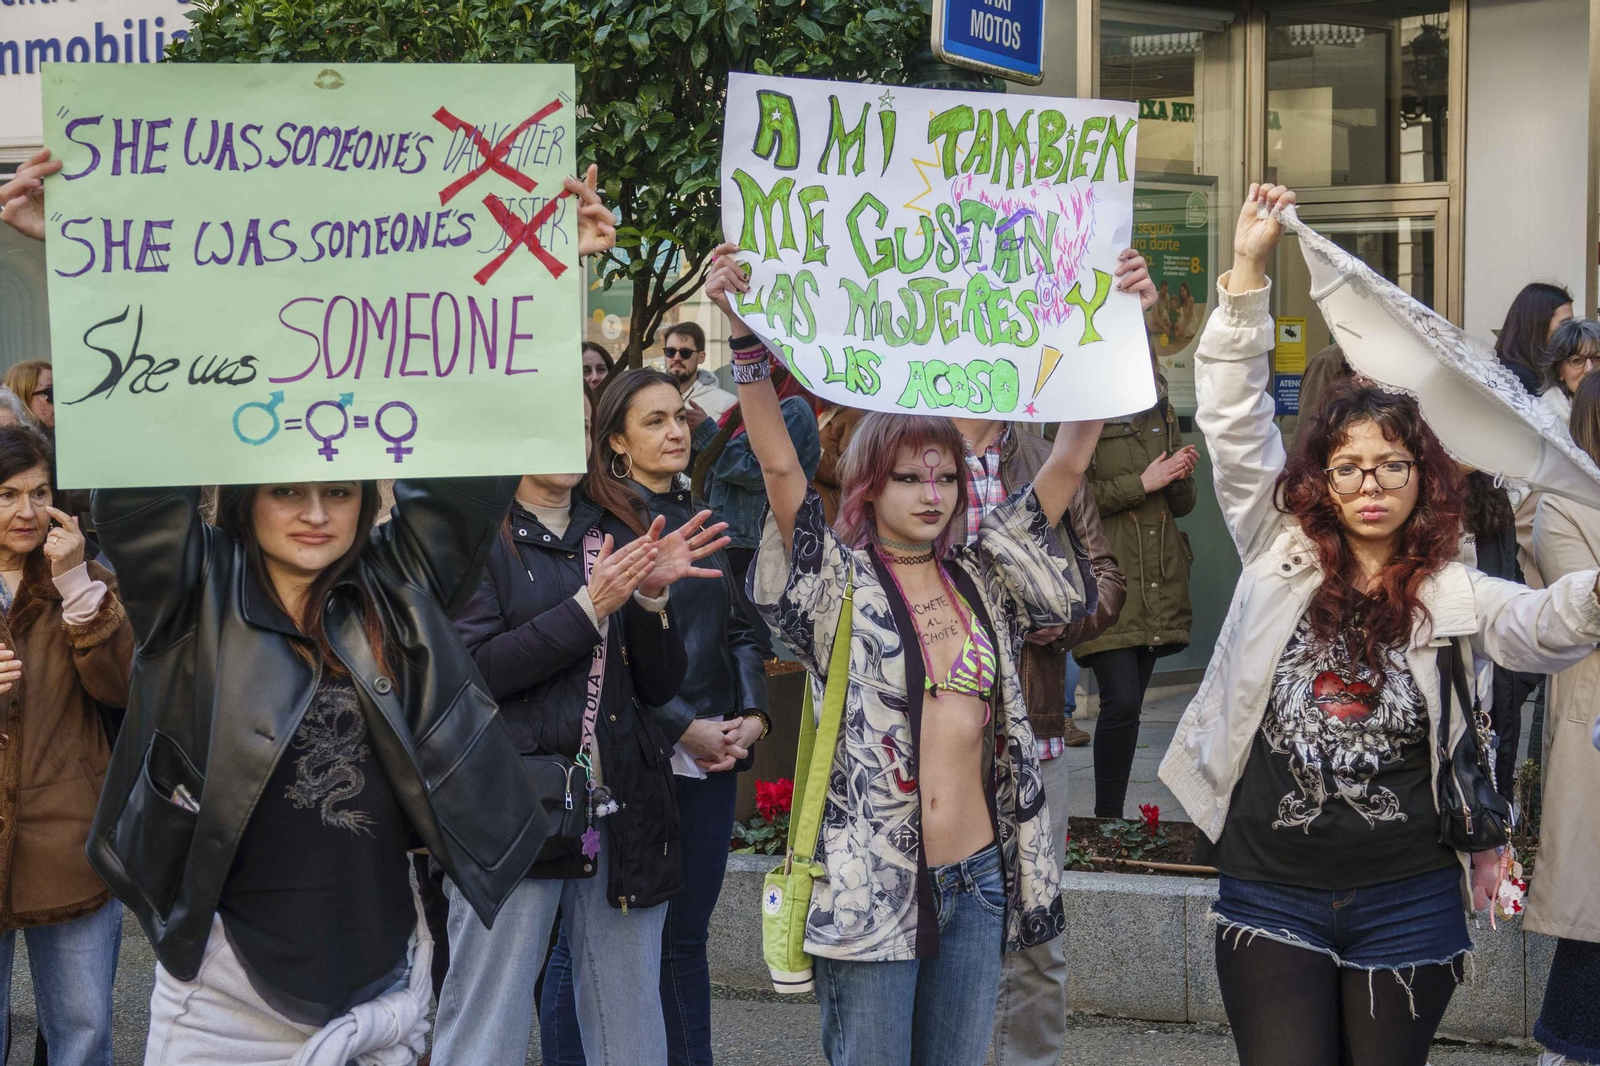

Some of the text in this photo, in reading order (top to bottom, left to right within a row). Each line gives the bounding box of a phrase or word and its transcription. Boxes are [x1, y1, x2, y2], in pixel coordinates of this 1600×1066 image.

[0, 16, 190, 75] nmobili
[970, 9, 1021, 50] MOTOS
[184, 117, 263, 172] WAS
[265, 121, 434, 174] SOMEONE'S
[751, 89, 800, 171] A
[194, 218, 298, 267] WAS
[300, 208, 476, 263] SOMEONE'S
[731, 172, 1059, 283] ME GUSTAN
[1138, 223, 1174, 238] seguro
[1150, 237, 1180, 251] darte
[838, 273, 1039, 347] MUJERES
[1064, 269, 1113, 347] Y
[61, 291, 538, 405] She was SOMEONE
[818, 345, 882, 396] LAS
[926, 617, 942, 629] AL
[585, 674, 602, 724] LOLA
